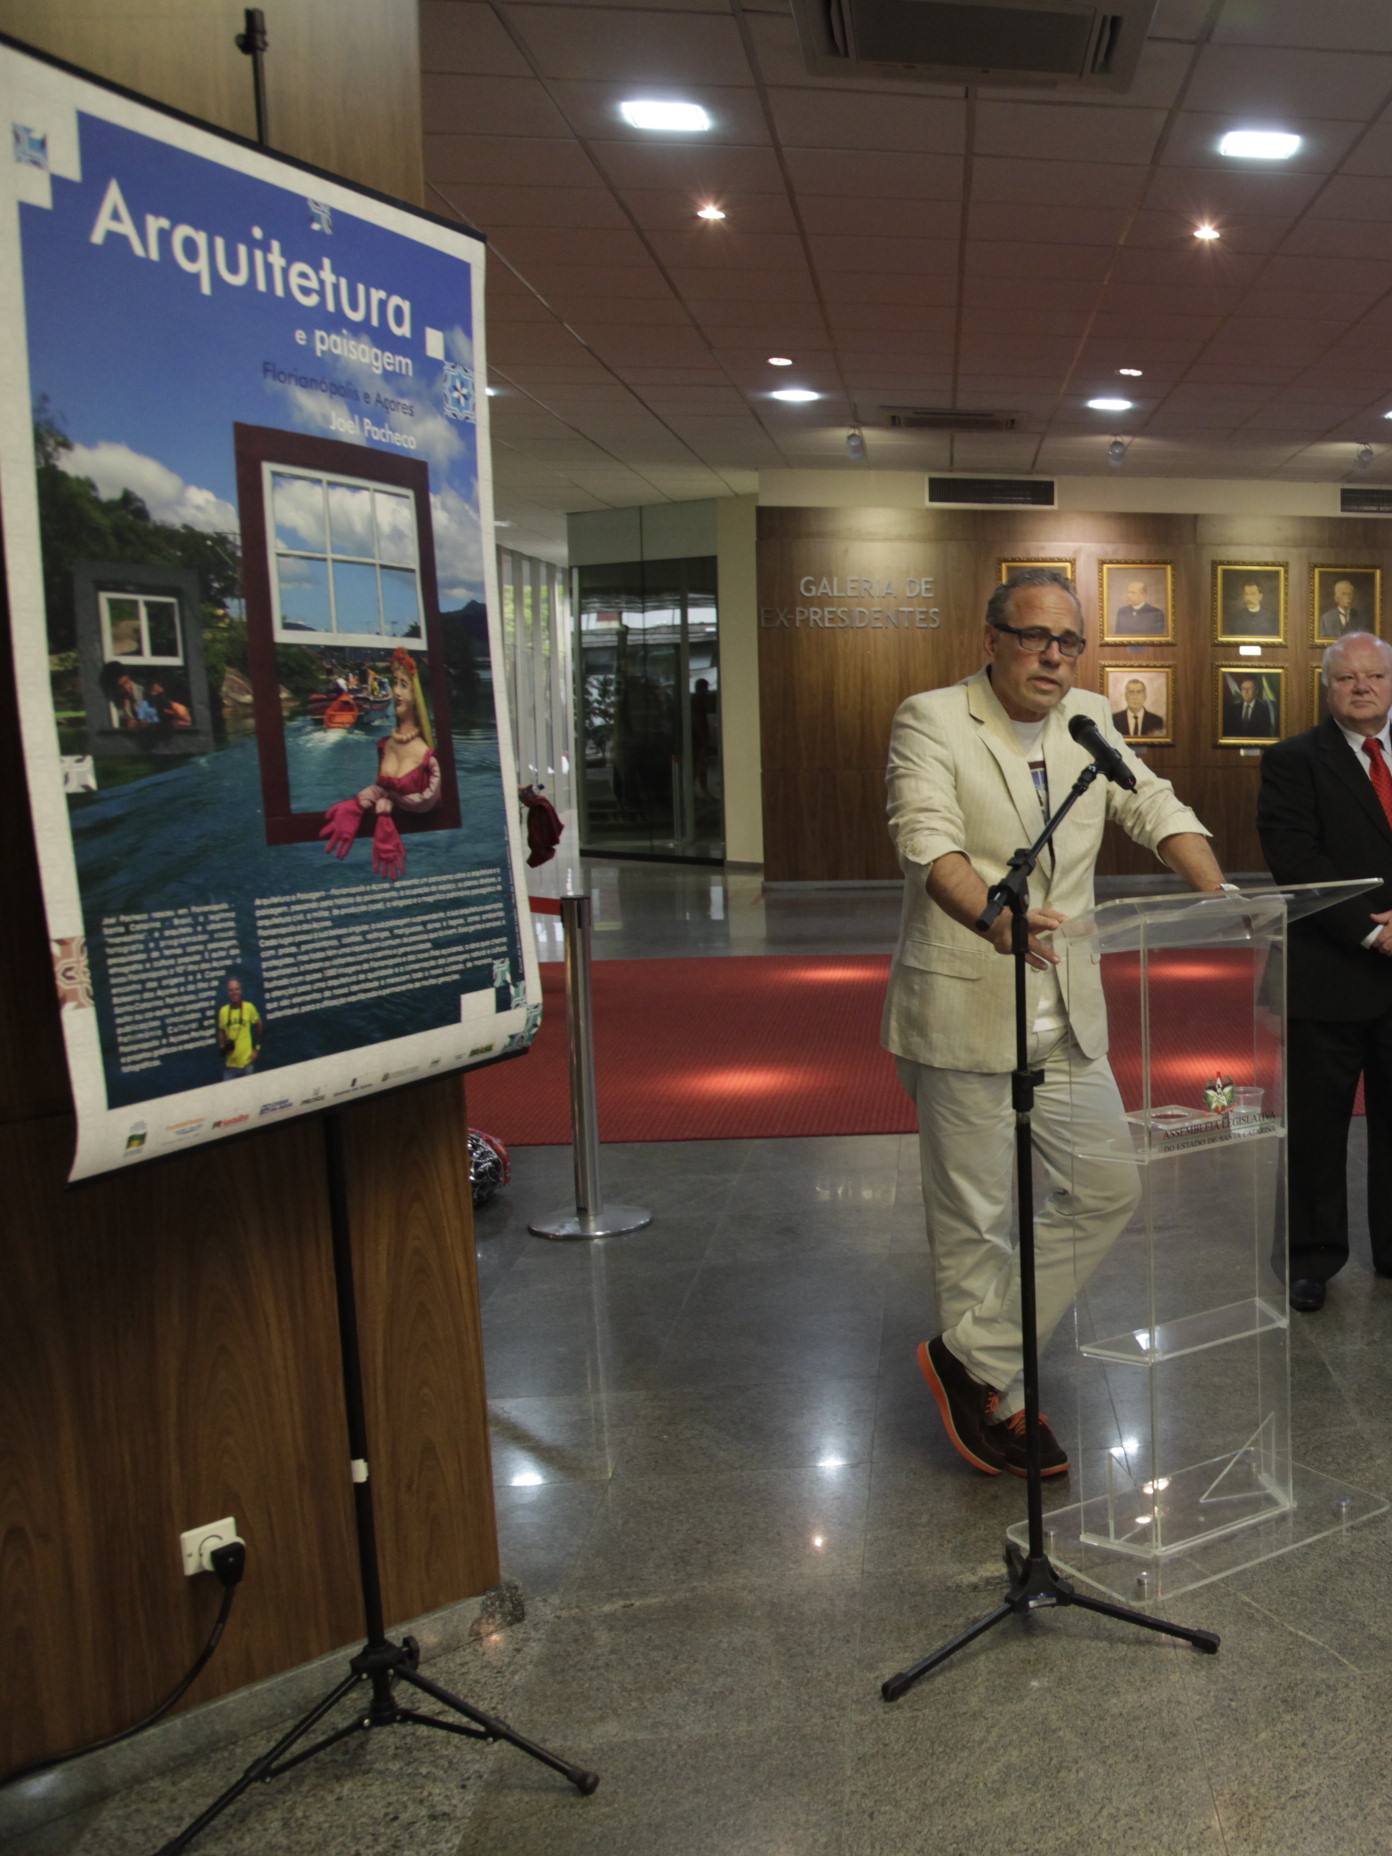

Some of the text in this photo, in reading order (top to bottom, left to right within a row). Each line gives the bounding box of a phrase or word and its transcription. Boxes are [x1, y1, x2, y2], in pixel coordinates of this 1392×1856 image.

[90, 177, 411, 338] Arquitetura
[294, 328, 413, 377] e paisagem
[262, 361, 415, 417] Florianópolis e Açores
[329, 410, 417, 449] Joel Pacheco
[800, 576, 934, 598] GALERIA DE
[760, 607, 940, 629] EX-PRESIDENTES
[1163, 1111, 1276, 1139] ASSEMBLEIA LEGISLATIVA
[1164, 1143, 1175, 1153] DO
[1176, 1138, 1206, 1151] ESTADO
[1217, 1132, 1241, 1142] SANTA
[1243, 1125, 1276, 1138] CATARINA
